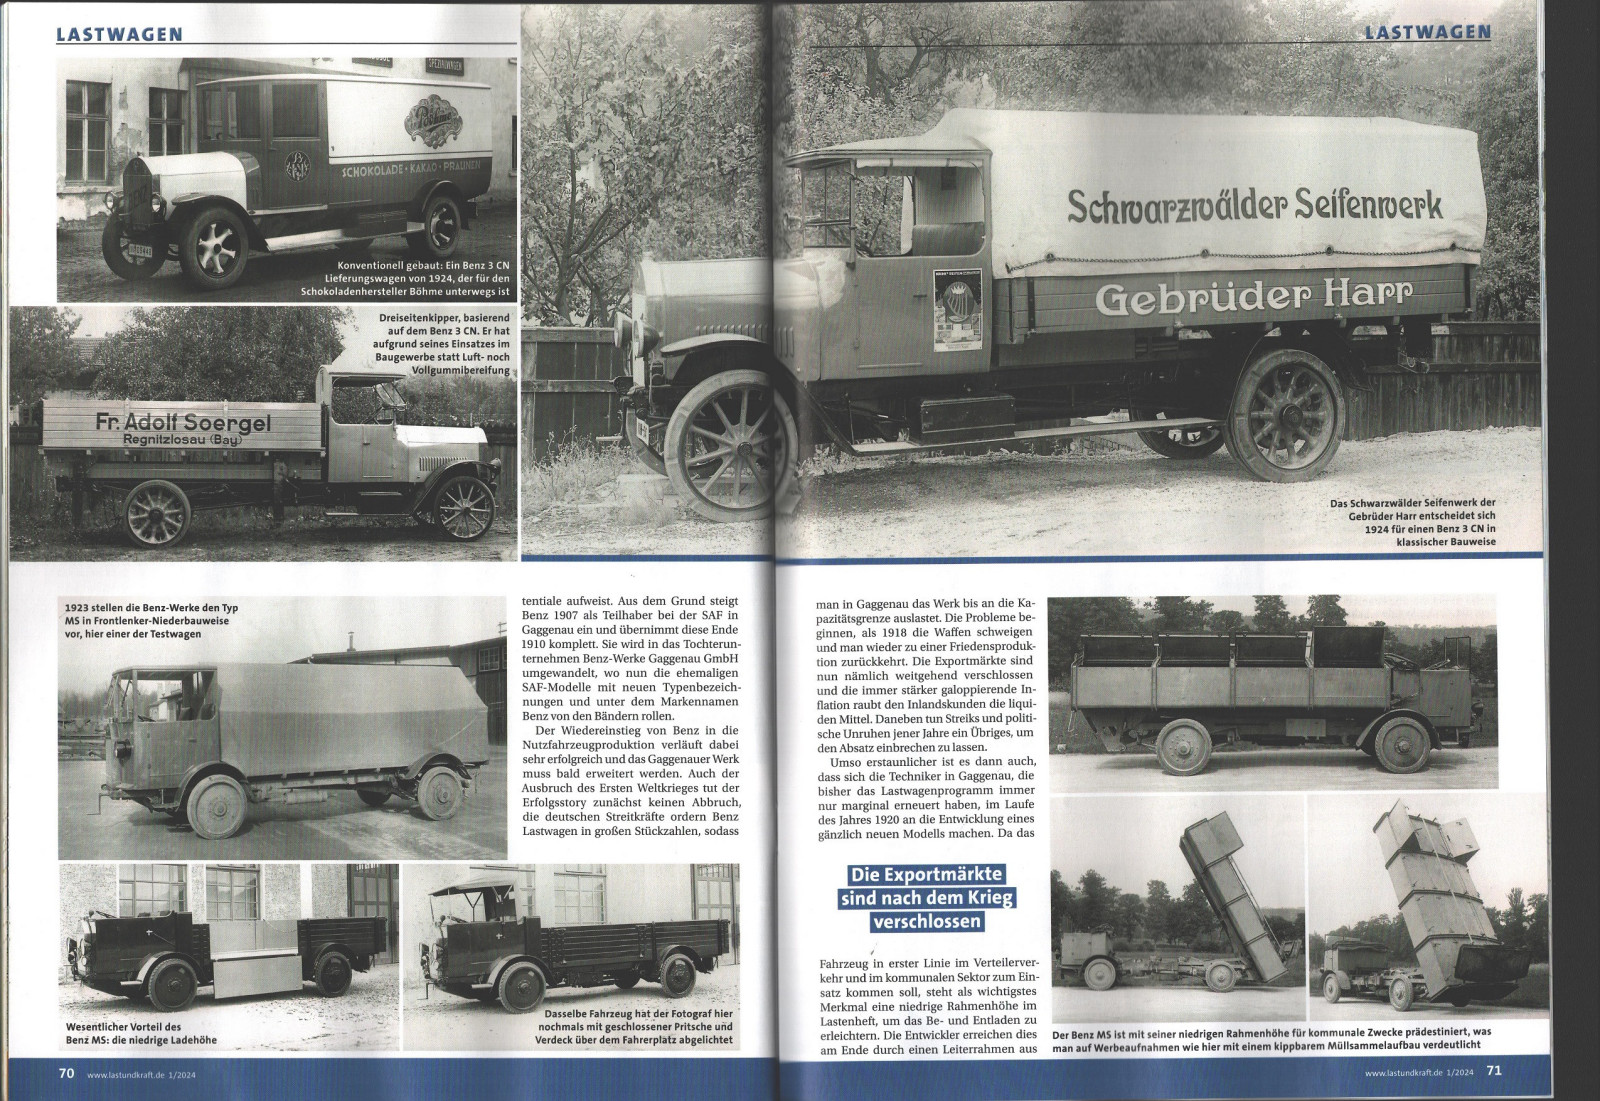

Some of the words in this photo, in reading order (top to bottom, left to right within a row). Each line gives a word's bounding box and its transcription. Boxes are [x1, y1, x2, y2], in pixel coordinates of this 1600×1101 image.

[57, 27, 183, 42] LASTWAGEN
[1365, 24, 1491, 39] LASTWAGEN
[342, 167, 403, 178] SCHOKOLADE
[410, 163, 437, 173] KAKAO
[443, 160, 481, 171] PRALINEN
[1068, 187, 1288, 224] Schwarzwälder
[1295, 187, 1444, 220] Seifenwerk
[338, 261, 403, 270] Konventionell
[406, 261, 443, 272] gebaut:
[446, 261, 460, 270] Ein
[463, 261, 485, 270] Benz
[488, 261, 493, 270] 3
[496, 261, 510, 270] CN
[325, 274, 406, 285] Lieferungswagen
[409, 275, 426, 283] von
[429, 274, 454, 284] 1924,
[458, 274, 473, 283] der
[476, 274, 489, 283] für
[492, 274, 510, 283] den
[301, 287, 407, 296] Schokoladenhersteller
[410, 287, 442, 296] Böhme
[446, 287, 495, 298] unterwegs
[499, 287, 510, 296] ist
[1095, 280, 1312, 316] Gebrüder
[1323, 277, 1414, 307] Harr
[380, 313, 461, 324] Dreiseitenkipper,
[464, 313, 510, 322] basierend
[388, 326, 404, 335] auf
[406, 326, 427, 335] dem
[430, 327, 452, 335] Benz
[456, 327, 460, 335] 3
[464, 327, 480, 335] CN.
[483, 327, 492, 335] Er
[494, 326, 510, 335] hat
[373, 340, 416, 350] aufgrund
[420, 340, 449, 348] seines
[452, 340, 495, 348] Einsatzes
[498, 340, 510, 348] im
[376, 352, 435, 363] Baugewerbe
[438, 353, 460, 361] statt
[463, 352, 484, 361] Luft-
[487, 352, 510, 361] noch
[412, 366, 510, 376] Vollgummibereifung
[96, 412, 120, 430] Fr.
[124, 412, 178, 431] Adolf
[184, 413, 271, 436] Soergel
[123, 433, 206, 446] Regnitzlosau
[210, 433, 243, 447] (Bay)
[1331, 498, 1348, 507] Das
[1350, 497, 1422, 507] Schwarzwälder
[1424, 498, 1477, 507] Seifenwerk
[1480, 497, 1496, 506] der
[1349, 511, 1393, 521] Gebrüder
[1396, 512, 1416, 520] Harr
[1419, 511, 1474, 520] entscheidet
[1478, 511, 1495, 520] sich
[1366, 525, 1389, 534] 1924
[1392, 524, 1405, 533] für
[1408, 525, 1434, 533] einen
[1437, 525, 1460, 533] Benz
[1471, 524, 1485, 533] CN
[1487, 524, 1496, 533] in
[1397, 537, 1448, 547] klassischer
[1451, 537, 1496, 546] Bauweise
[522, 596, 561, 605] tentiale
[566, 596, 613, 605] aufweist.
[618, 596, 638, 605] Aus
[643, 596, 666, 605] dem
[671, 596, 705, 605] Grund
[710, 596, 738, 608] steigt
[66, 604, 88, 612] 1923
[92, 603, 122, 612] stellen
[126, 603, 140, 612] die
[143, 603, 199, 612] Benz-Werke
[202, 603, 219, 612] den
[222, 603, 238, 614] Typ
[65, 617, 80, 625] MS
[83, 616, 91, 625] in
[94, 616, 229, 626] Frontlenker-Niederbauweise
[816, 614, 890, 626] pazitätsgrenze
[894, 613, 941, 623] auslastet.
[945, 613, 962, 622] Die
[966, 612, 1016, 622] Probleme
[1019, 612, 1035, 621] be-
[65, 631, 82, 640] vor,
[86, 629, 104, 638] hier
[106, 630, 130, 638] einer
[133, 629, 148, 638] der
[150, 630, 201, 640] Testwagen
[852, 867, 880, 881] Die
[885, 866, 1002, 885] Exportmärkte
[842, 890, 876, 905] sind
[882, 890, 921, 905] nach
[926, 889, 963, 905] dem
[969, 889, 1013, 908] Krieg
[874, 913, 980, 928] verschlossen
[820, 959, 868, 970] Fahrzeug
[873, 959, 884, 968] in
[888, 960, 919, 968] erster
[924, 959, 950, 968] Linie
[955, 959, 969, 968] im
[974, 957, 1039, 968] Verteilerver-
[545, 1009, 586, 1018] Dasselbe
[590, 1010, 632, 1020] Fahrzeug
[635, 1009, 650, 1018] hat
[653, 1009, 669, 1018] der
[672, 1009, 712, 1019] Fotograf
[715, 1009, 733, 1018] hier
[66, 1022, 128, 1031] Wesentlicher
[130, 1022, 162, 1031] Vorteil
[165, 1022, 181, 1031] des
[539, 1022, 584, 1031] nochmals
[587, 1022, 602, 1031] mit
[605, 1022, 672, 1033] geschlossener
[675, 1022, 712, 1031] Pritsche
[715, 1022, 733, 1031] und
[1053, 1031, 1069, 1040] Der
[1072, 1031, 1094, 1039] Benz
[1097, 1030, 1111, 1039] MS
[1114, 1030, 1125, 1039] ist
[1129, 1030, 1144, 1039] mit
[1148, 1030, 1176, 1038] seiner
[1179, 1029, 1223, 1040] niedrigen
[1227, 1029, 1289, 1038] Rahmenhöhe
[1292, 1028, 1306, 1038] für
[1309, 1028, 1365, 1037] kommunale
[1368, 1028, 1402, 1037] Zwecke
[1406, 1027, 1470, 1038] prädestiniert,
[1473, 1028, 1491, 1036] was
[66, 1036, 88, 1044] Benz
[92, 1036, 109, 1044] MS:
[112, 1035, 126, 1044] die
[129, 1036, 168, 1046] niedrige
[171, 1036, 217, 1044] Ladehöhe
[535, 1036, 572, 1044] Verdeck
[576, 1036, 597, 1044] über
[600, 1035, 620, 1044] dem
[623, 1035, 676, 1046] Fahrerplatz
[679, 1035, 733, 1046] abgelichtet
[59, 1068, 75, 1079] 70
[87, 1071, 165, 1079] www.lastundkraft.de
[168, 1071, 196, 1080] 1/2024
[1365, 1068, 1443, 1077] www.lastundkraft.de
[1447, 1068, 1474, 1077] 1/2024
[1487, 1065, 1502, 1076] 71
